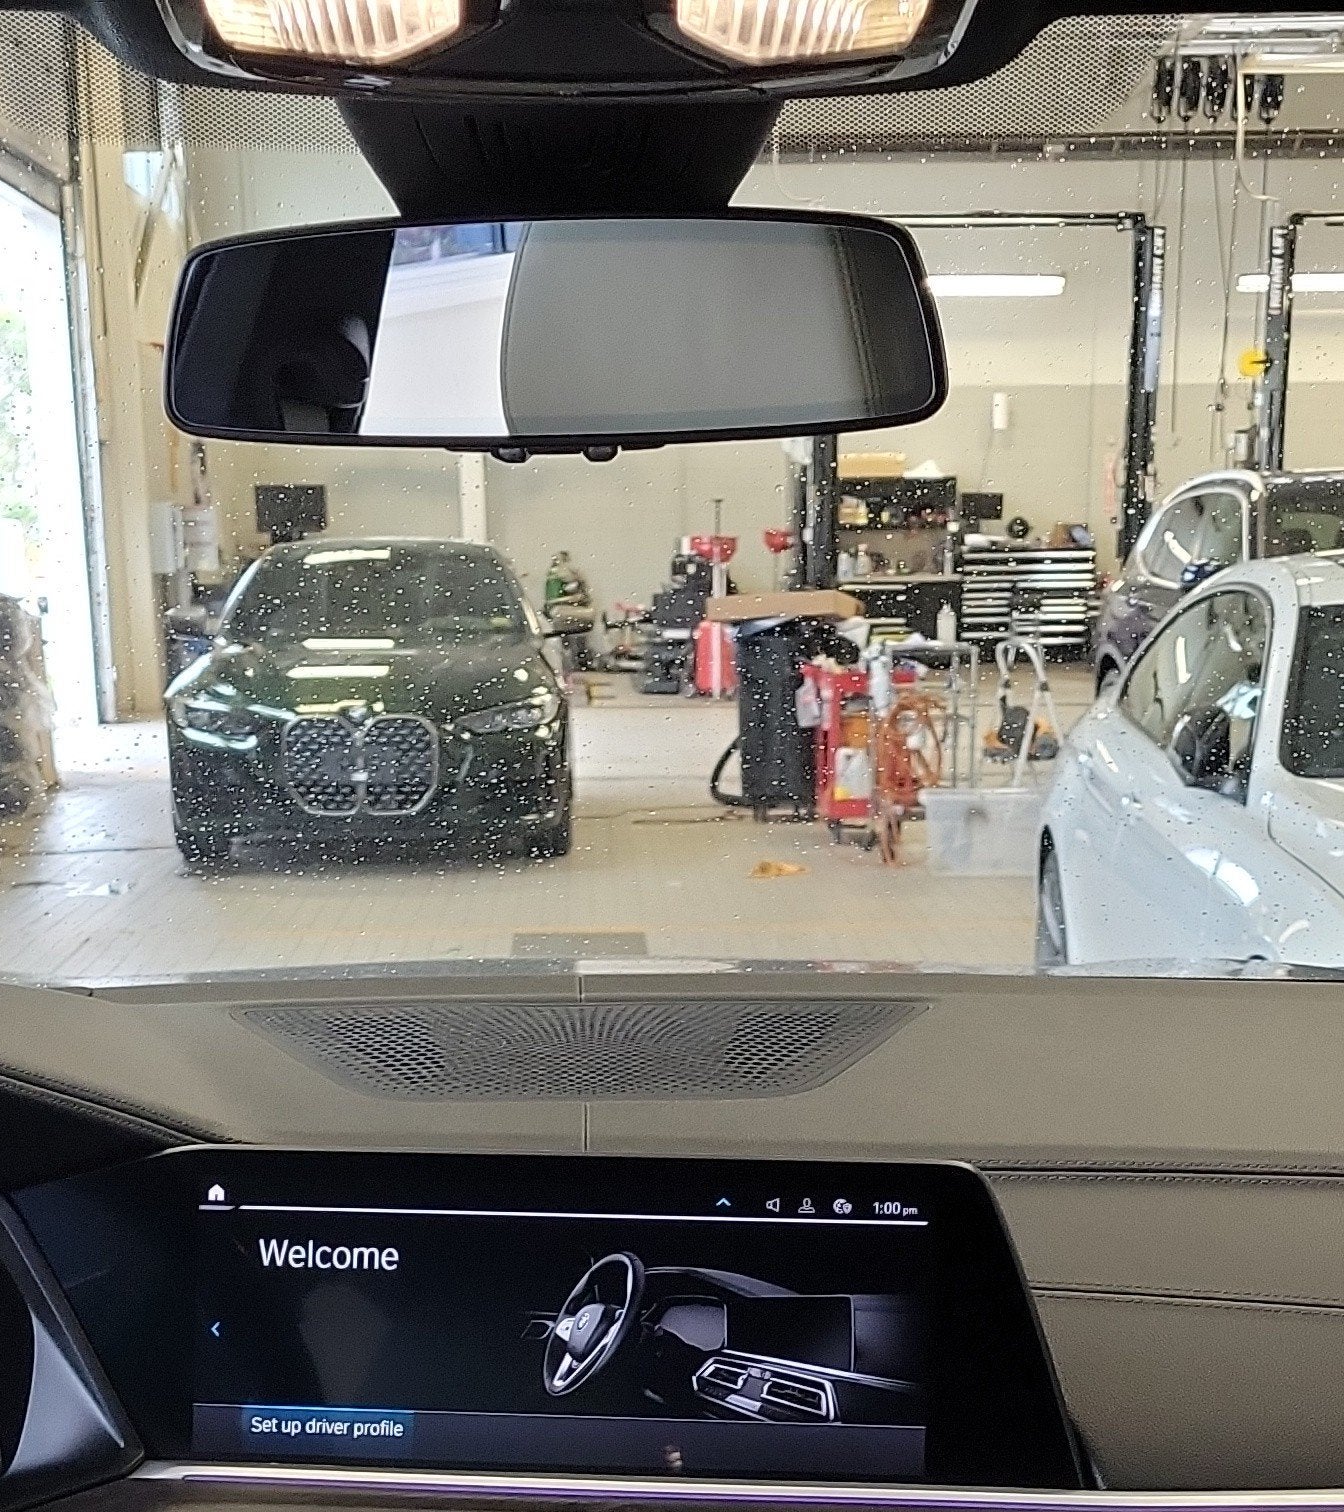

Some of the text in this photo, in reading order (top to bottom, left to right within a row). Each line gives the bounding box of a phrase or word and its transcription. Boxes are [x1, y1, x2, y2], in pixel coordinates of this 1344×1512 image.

[872, 1201, 918, 1217] 1:00 pm
[259, 1238, 399, 1272] Welcome
[250, 1416, 404, 1439] Set up driver profile
